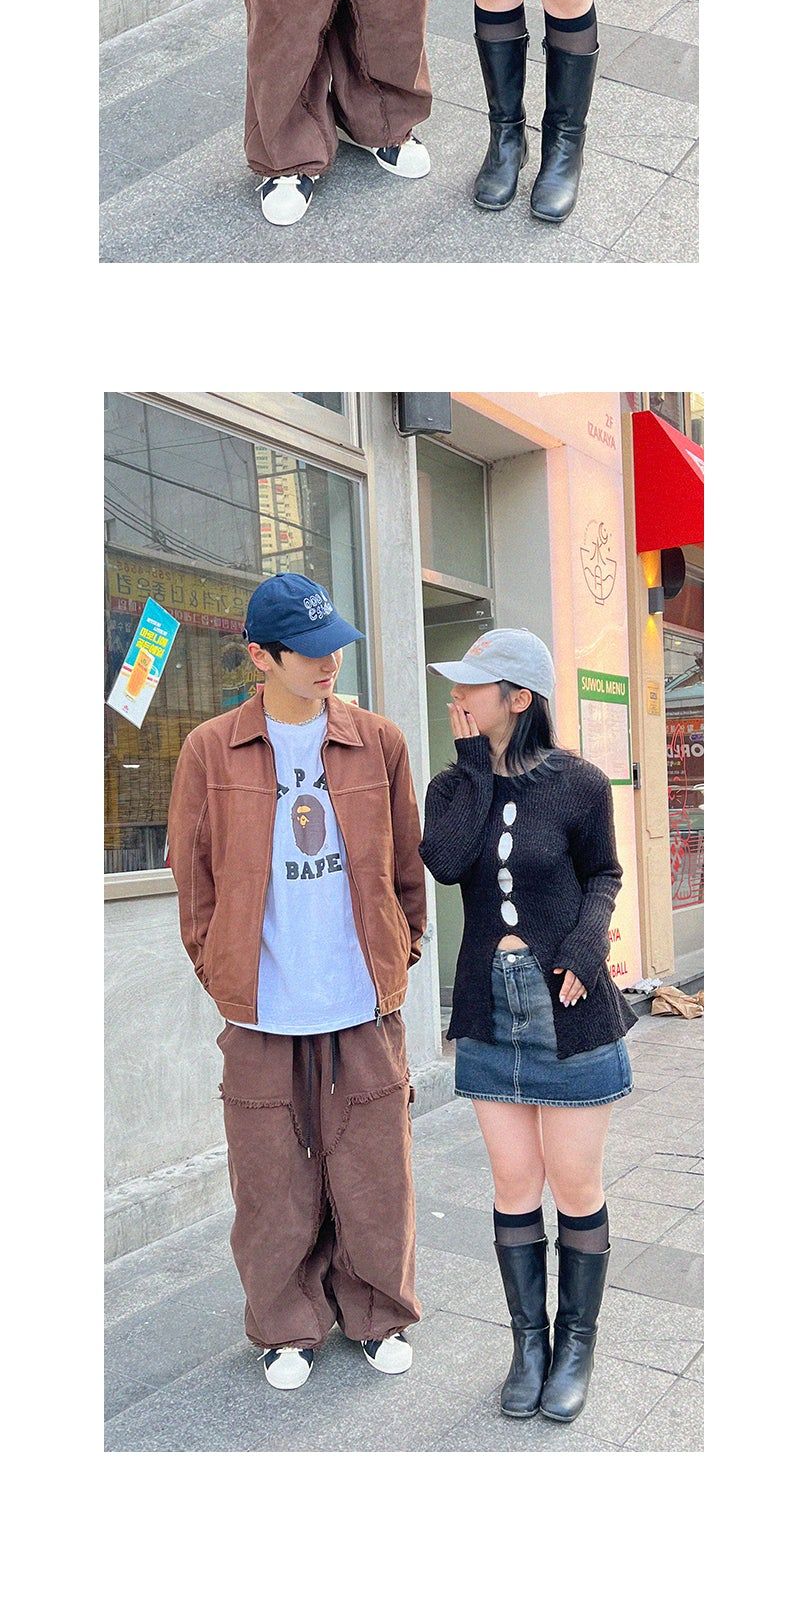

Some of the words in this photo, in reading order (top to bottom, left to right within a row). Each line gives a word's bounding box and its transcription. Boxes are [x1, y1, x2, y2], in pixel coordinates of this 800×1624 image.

[587, 421, 616, 450] IZAKAYA
[581, 676, 605, 693] SUWOL
[605, 680, 625, 696] MENU
[285, 853, 343, 880] BAPE
[610, 961, 628, 978] BALL
